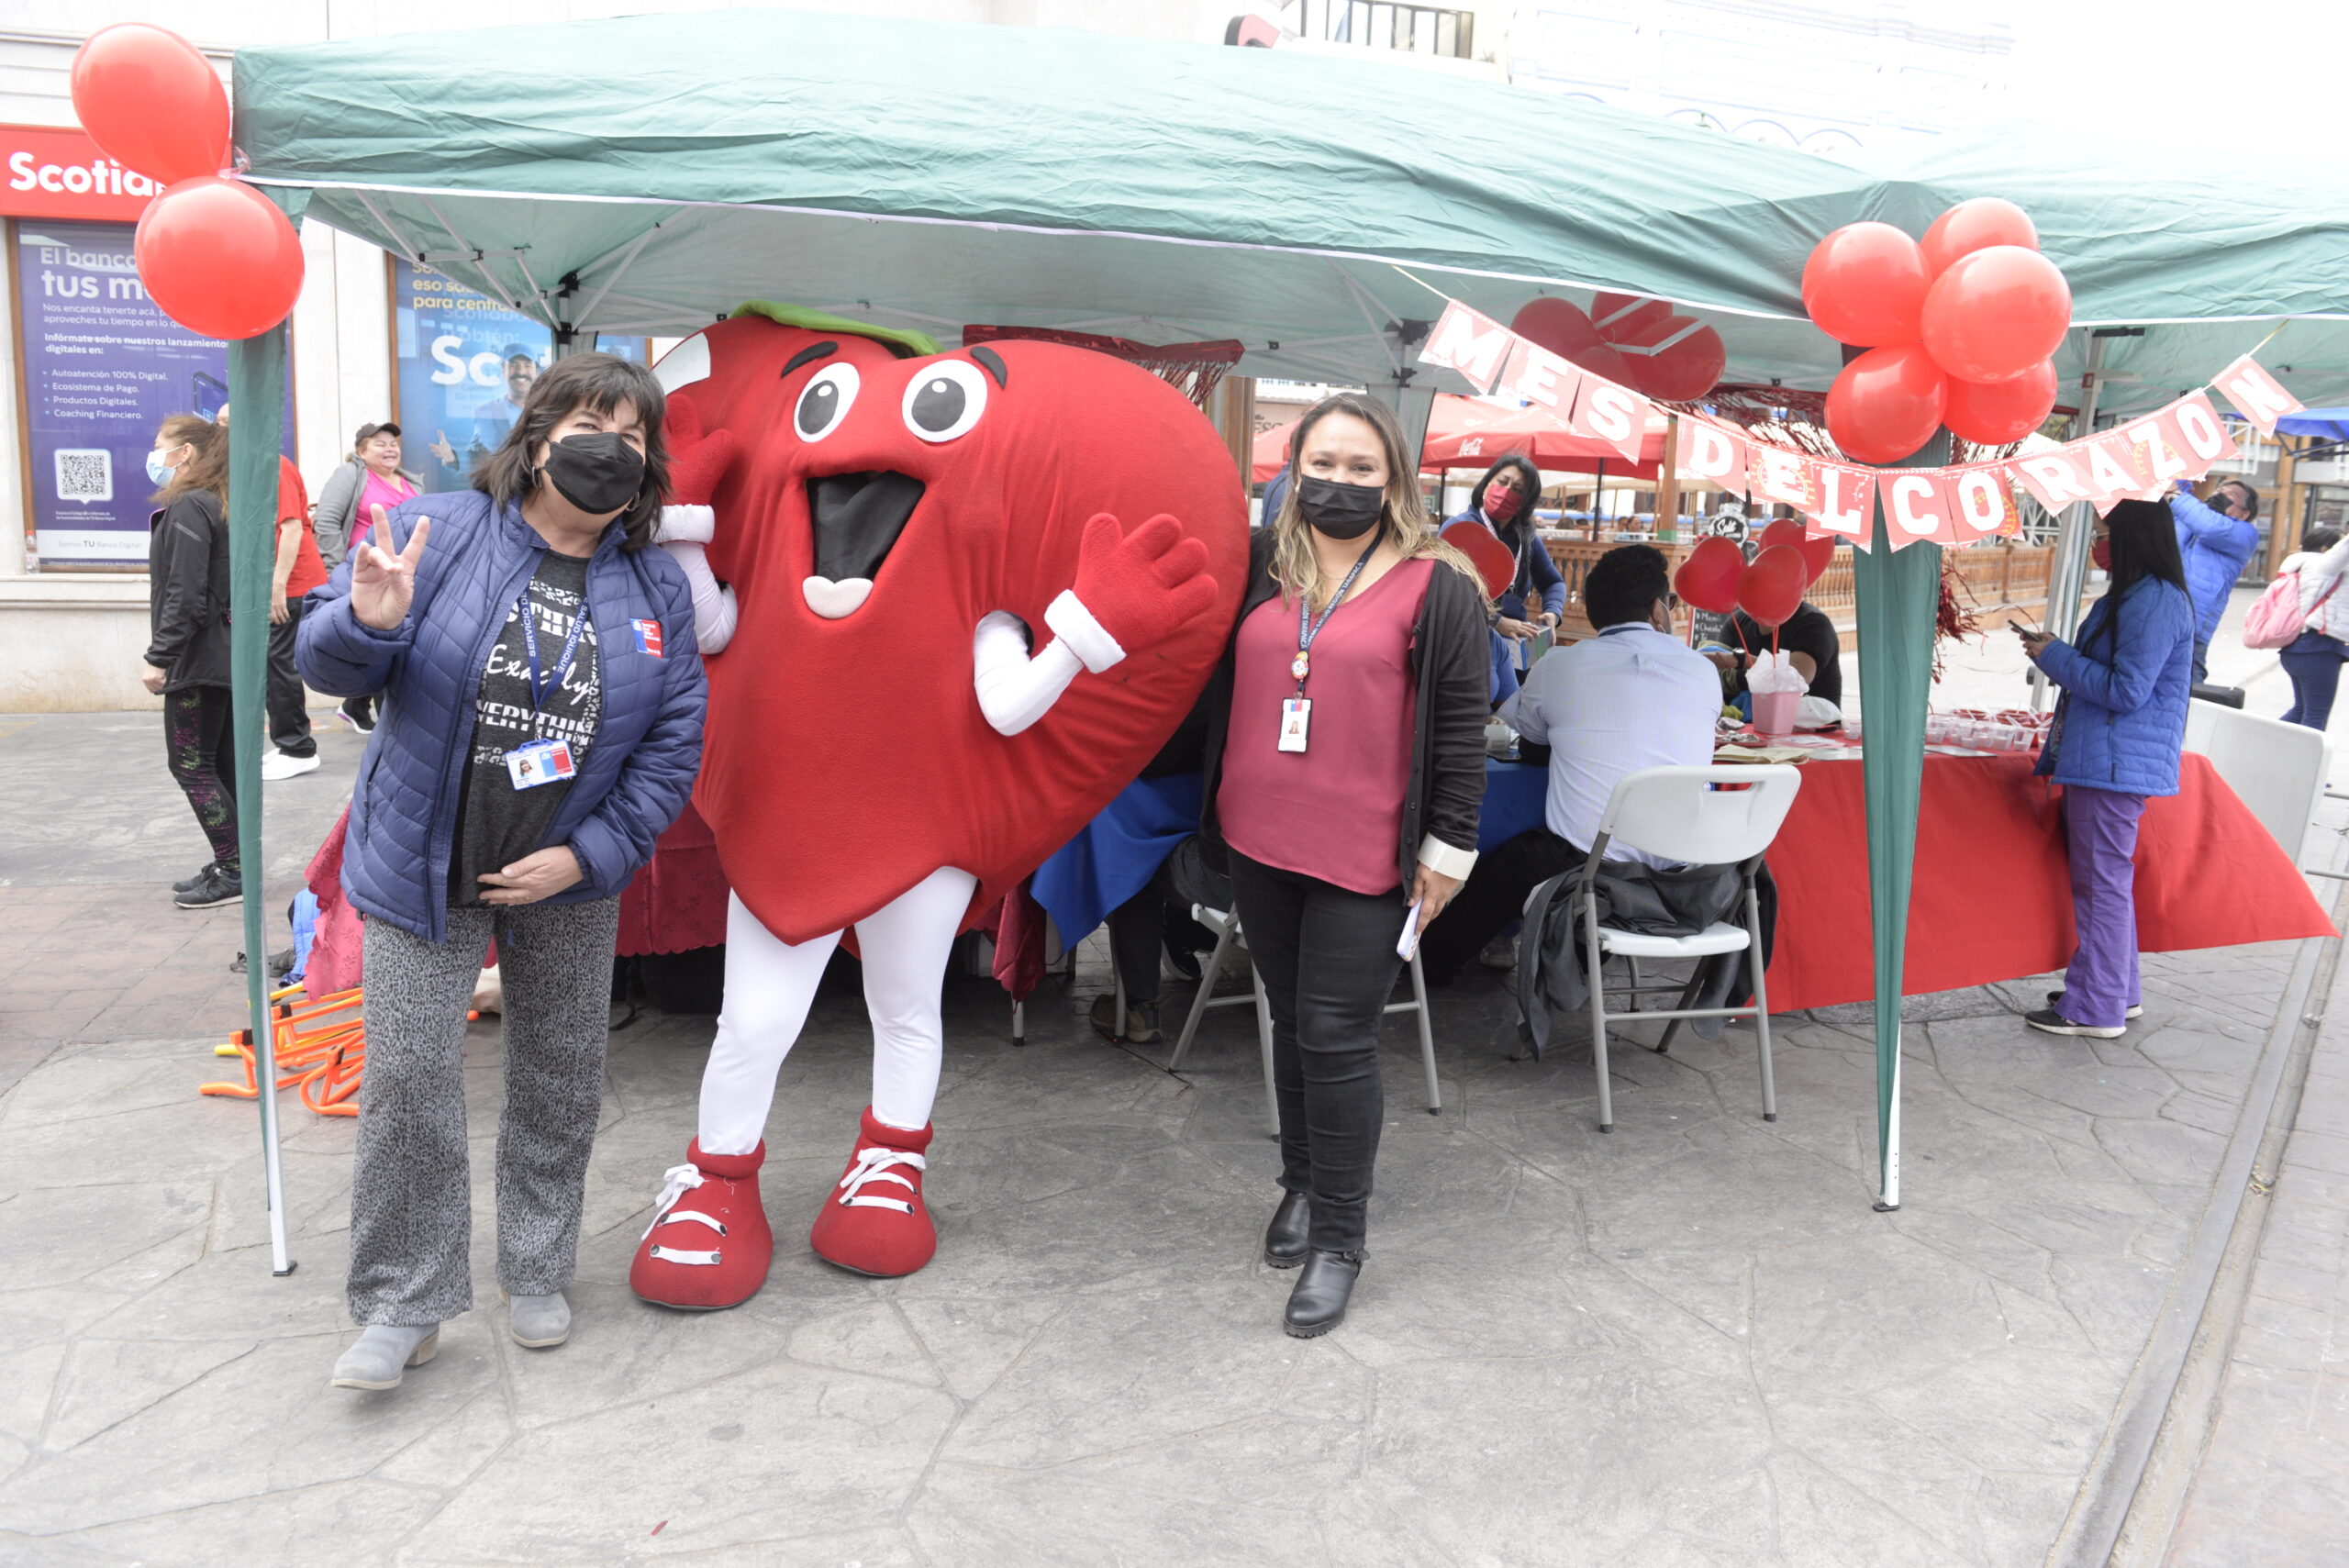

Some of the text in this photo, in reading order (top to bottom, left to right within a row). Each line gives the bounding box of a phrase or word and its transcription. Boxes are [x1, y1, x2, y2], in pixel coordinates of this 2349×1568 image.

[9, 151, 166, 196] Scotia
[40, 247, 60, 265] El
[40, 270, 100, 299] tus
[412, 280, 442, 292] eso
[413, 296, 453, 310] para
[43, 303, 61, 313] Nos
[63, 305, 101, 315] encanta
[103, 306, 138, 317] tenerte
[43, 315, 96, 326] aproveches
[98, 317, 108, 326] tu
[110, 317, 143, 328] tiempo
[146, 319, 158, 328] en
[159, 318, 168, 328] lo
[44, 333, 93, 344] Infórmate
[95, 334, 122, 345] sobre
[124, 336, 166, 346] nuestros
[45, 346, 104, 356] digitales en:
[51, 369, 168, 382] Autoatención 100% Digital.
[52, 382, 140, 395] Ecosistema de Pago.
[53, 395, 139, 407] Productos Digitales.
[54, 408, 143, 420] Coaching Financiero.
[1431, 308, 2291, 535] MES DEL CORAZON
[83, 539, 95, 548] TU
[521, 607, 536, 657] SERVICIO
[557, 605, 588, 674] SALUD IQUIQUE
